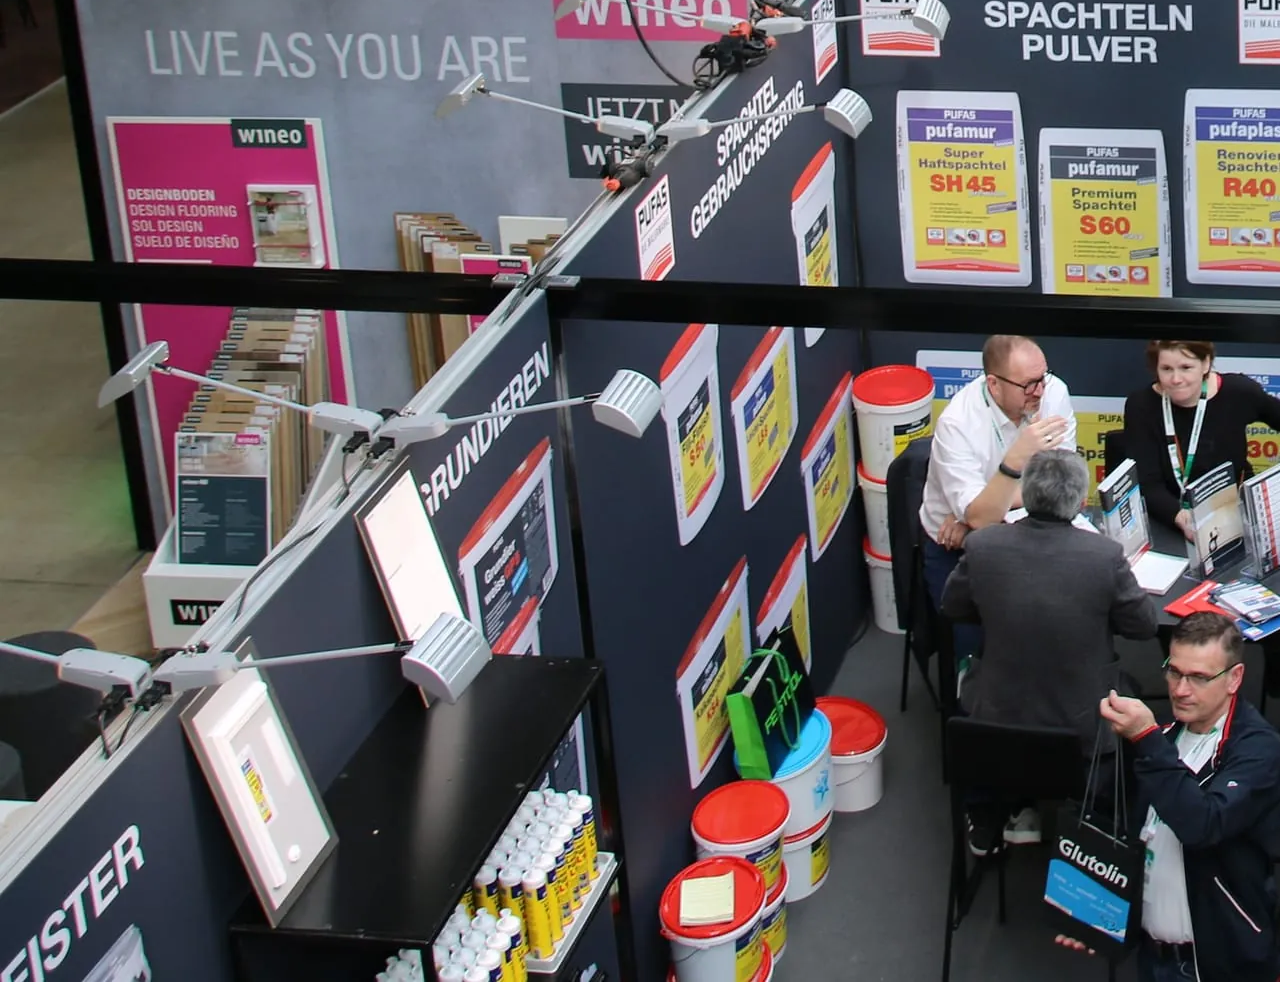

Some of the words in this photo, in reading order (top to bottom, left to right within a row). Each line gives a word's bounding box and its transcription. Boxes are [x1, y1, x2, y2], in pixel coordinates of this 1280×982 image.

[983, 0, 1193, 31] SPACHTELN
[1244, 20, 1257, 29] DIE
[1022, 34, 1158, 64] PULVER
[145, 30, 243, 76] LIVE
[255, 32, 316, 78] AS
[325, 33, 422, 81] YOU
[437, 36, 531, 83] ARE
[943, 110, 976, 120] PUFAS
[1233, 108, 1266, 118] PUFAS
[717, 76, 778, 166] SPACHTEL
[237, 128, 302, 144] wineo
[926, 123, 997, 141] pufamur
[691, 80, 805, 238] GEBRAUCHSFERTIG
[943, 147, 984, 159] Super
[1087, 147, 1119, 157] PUFAS
[919, 158, 1007, 171] Haftspachtel
[1068, 160, 1140, 178] pufamur
[1072, 187, 1137, 200] Premium
[1223, 177, 1276, 197] R40
[128, 189, 216, 202] DESIGNBODEN
[130, 204, 177, 217] DESIGN
[178, 205, 238, 218] FLOORING
[638, 184, 668, 234] PUFAS
[1073, 199, 1137, 212] Spachtel
[132, 220, 156, 232] SOL
[158, 221, 203, 233] DESIGN
[135, 235, 174, 248] SUELO
[175, 236, 190, 248] DE
[194, 234, 239, 249] DISEÑO
[961, 369, 984, 378] PUF
[1098, 414, 1123, 423] PUFA
[1059, 838, 1128, 889] Glutolin
